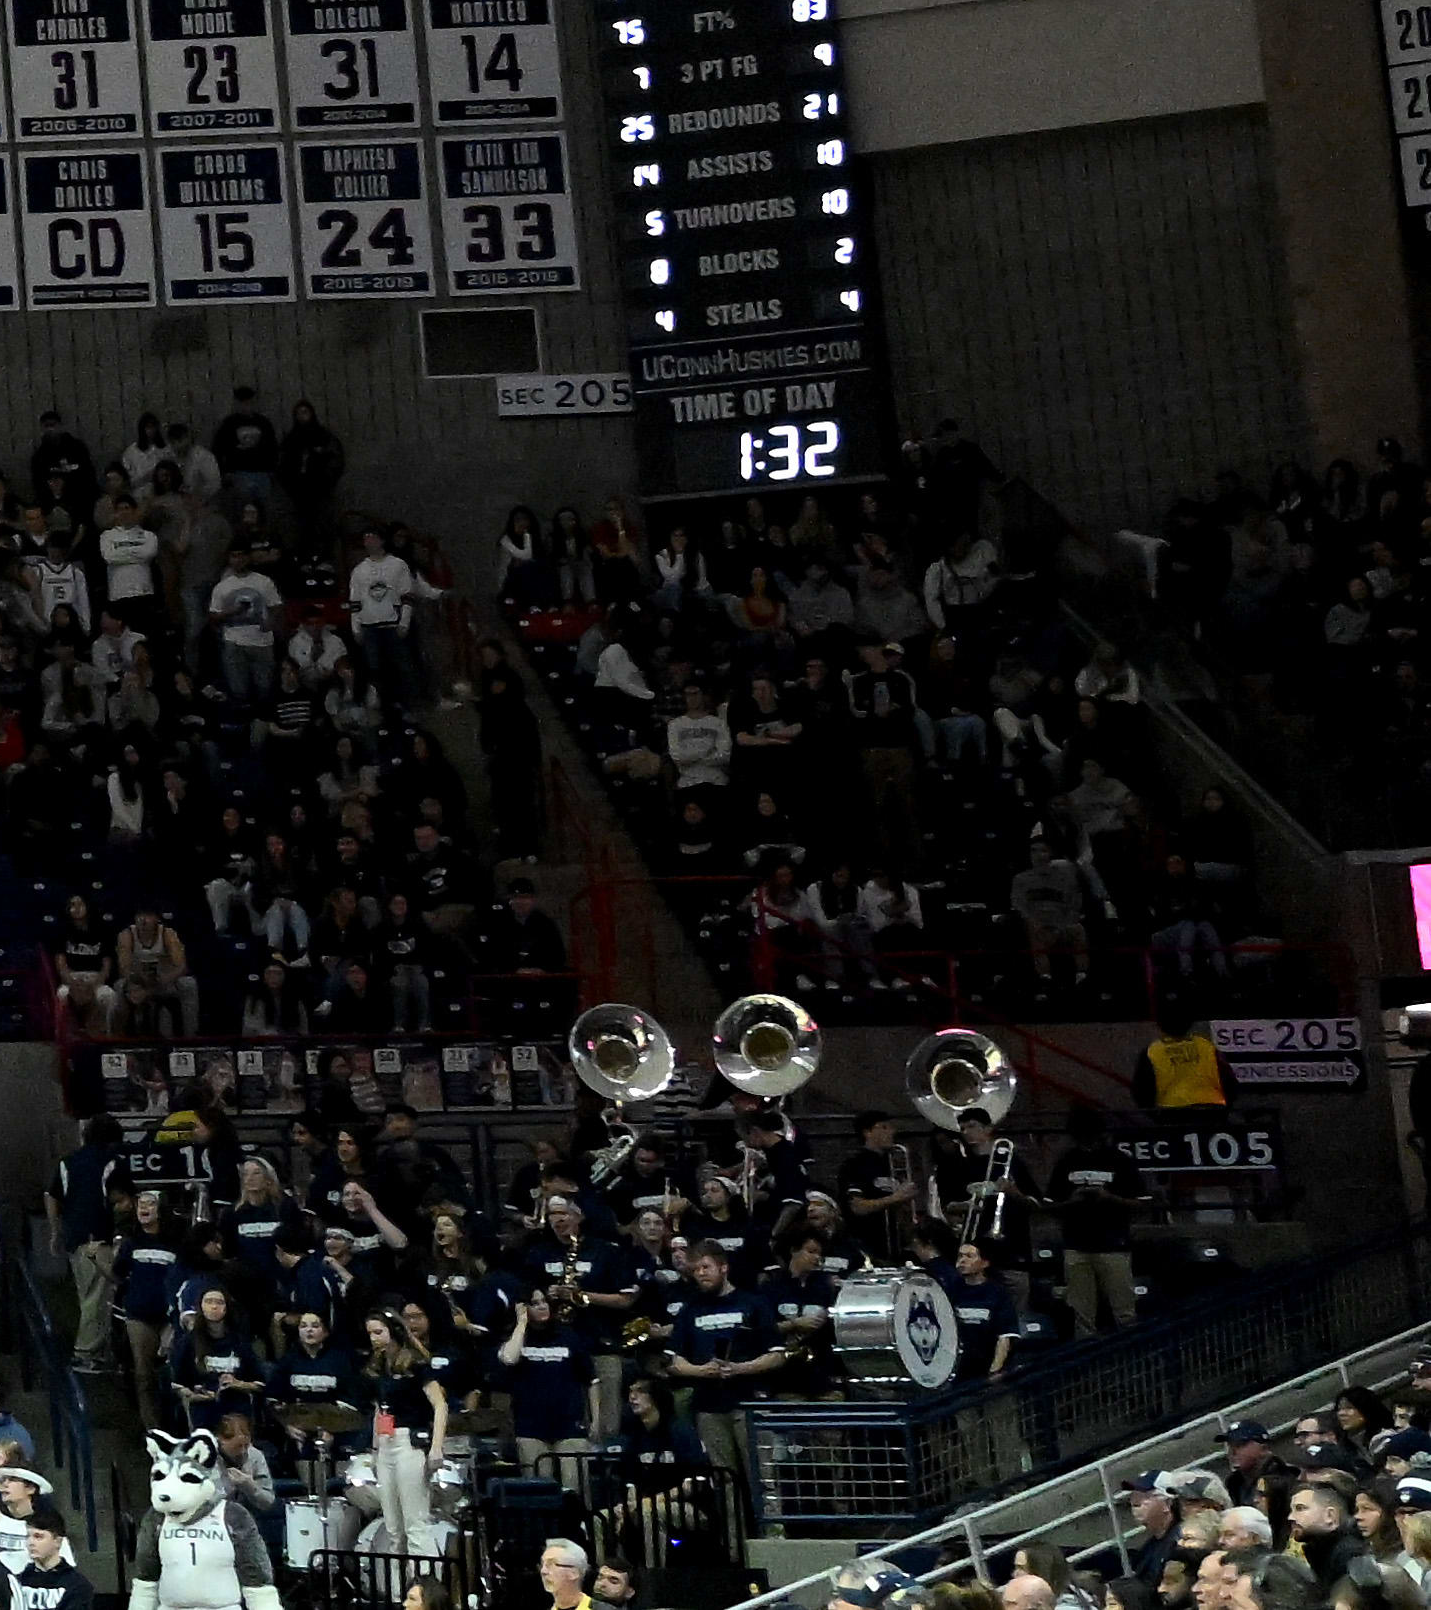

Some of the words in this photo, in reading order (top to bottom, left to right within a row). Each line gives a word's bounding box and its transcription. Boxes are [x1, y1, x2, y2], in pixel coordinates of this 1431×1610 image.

[694, 10, 735, 33] FT%
[51, 50, 99, 110] 31
[184, 45, 240, 105] 23
[321, 38, 380, 101] 31
[461, 33, 523, 94] 14
[668, 101, 781, 133] REBOUNDS
[687, 150, 773, 180] ASSISTS
[674, 196, 796, 230] TURNOVERS
[47, 217, 125, 280] CD
[195, 212, 255, 273] 15
[317, 207, 414, 268] 24
[463, 202, 556, 263] 33
[699, 248, 779, 276] BLOCKS
[706, 298, 783, 326] STEALS
[501, 388, 545, 404] SEC
[554, 379, 631, 408] 205
[670, 391, 736, 423] TIME
[743, 389, 777, 416] OF
[785, 381, 836, 413] DAY
[740, 421, 839, 480] 1:32
[1217, 1028, 1264, 1046] SEC
[1276, 1021, 1356, 1050] 205
[1183, 1132, 1273, 1165] 105
[163, 1528, 224, 1542] UCONN
